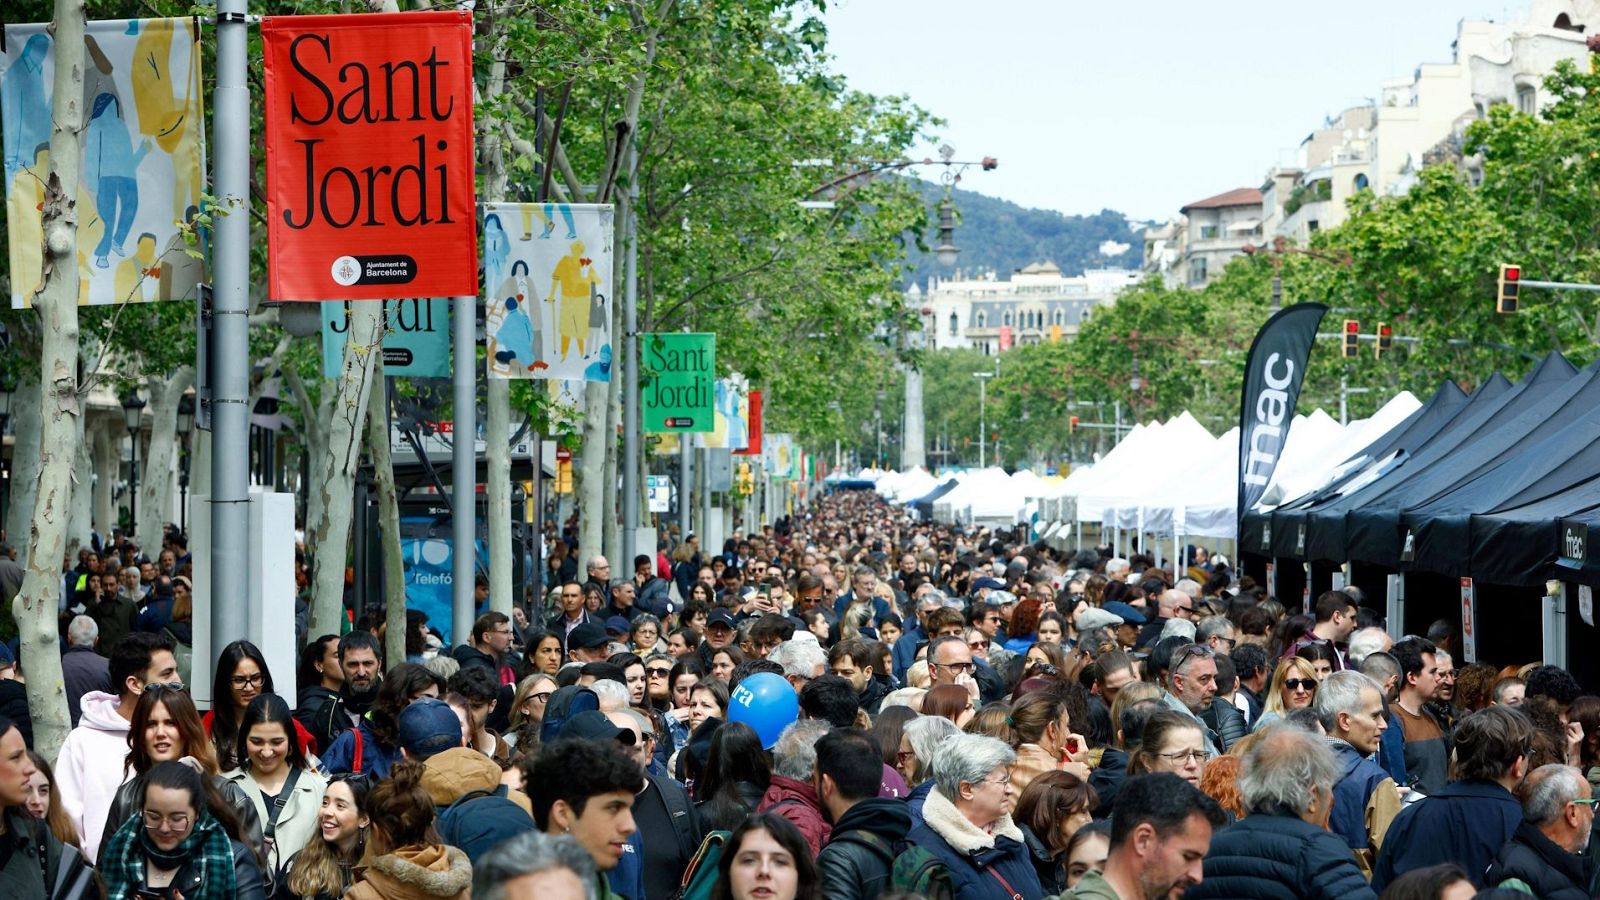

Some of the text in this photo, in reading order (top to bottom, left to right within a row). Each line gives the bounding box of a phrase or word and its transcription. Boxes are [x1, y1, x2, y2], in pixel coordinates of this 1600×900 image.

[290, 33, 454, 127] Sant
[283, 134, 456, 230] Jordi
[366, 268, 408, 277] Barcelona
[330, 297, 436, 334] Jrdi
[650, 340, 709, 372] Sant
[646, 375, 708, 408] Jordi
[1243, 352, 1295, 487] fnac
[1565, 527, 1584, 560] fnac
[731, 683, 754, 708] ra
